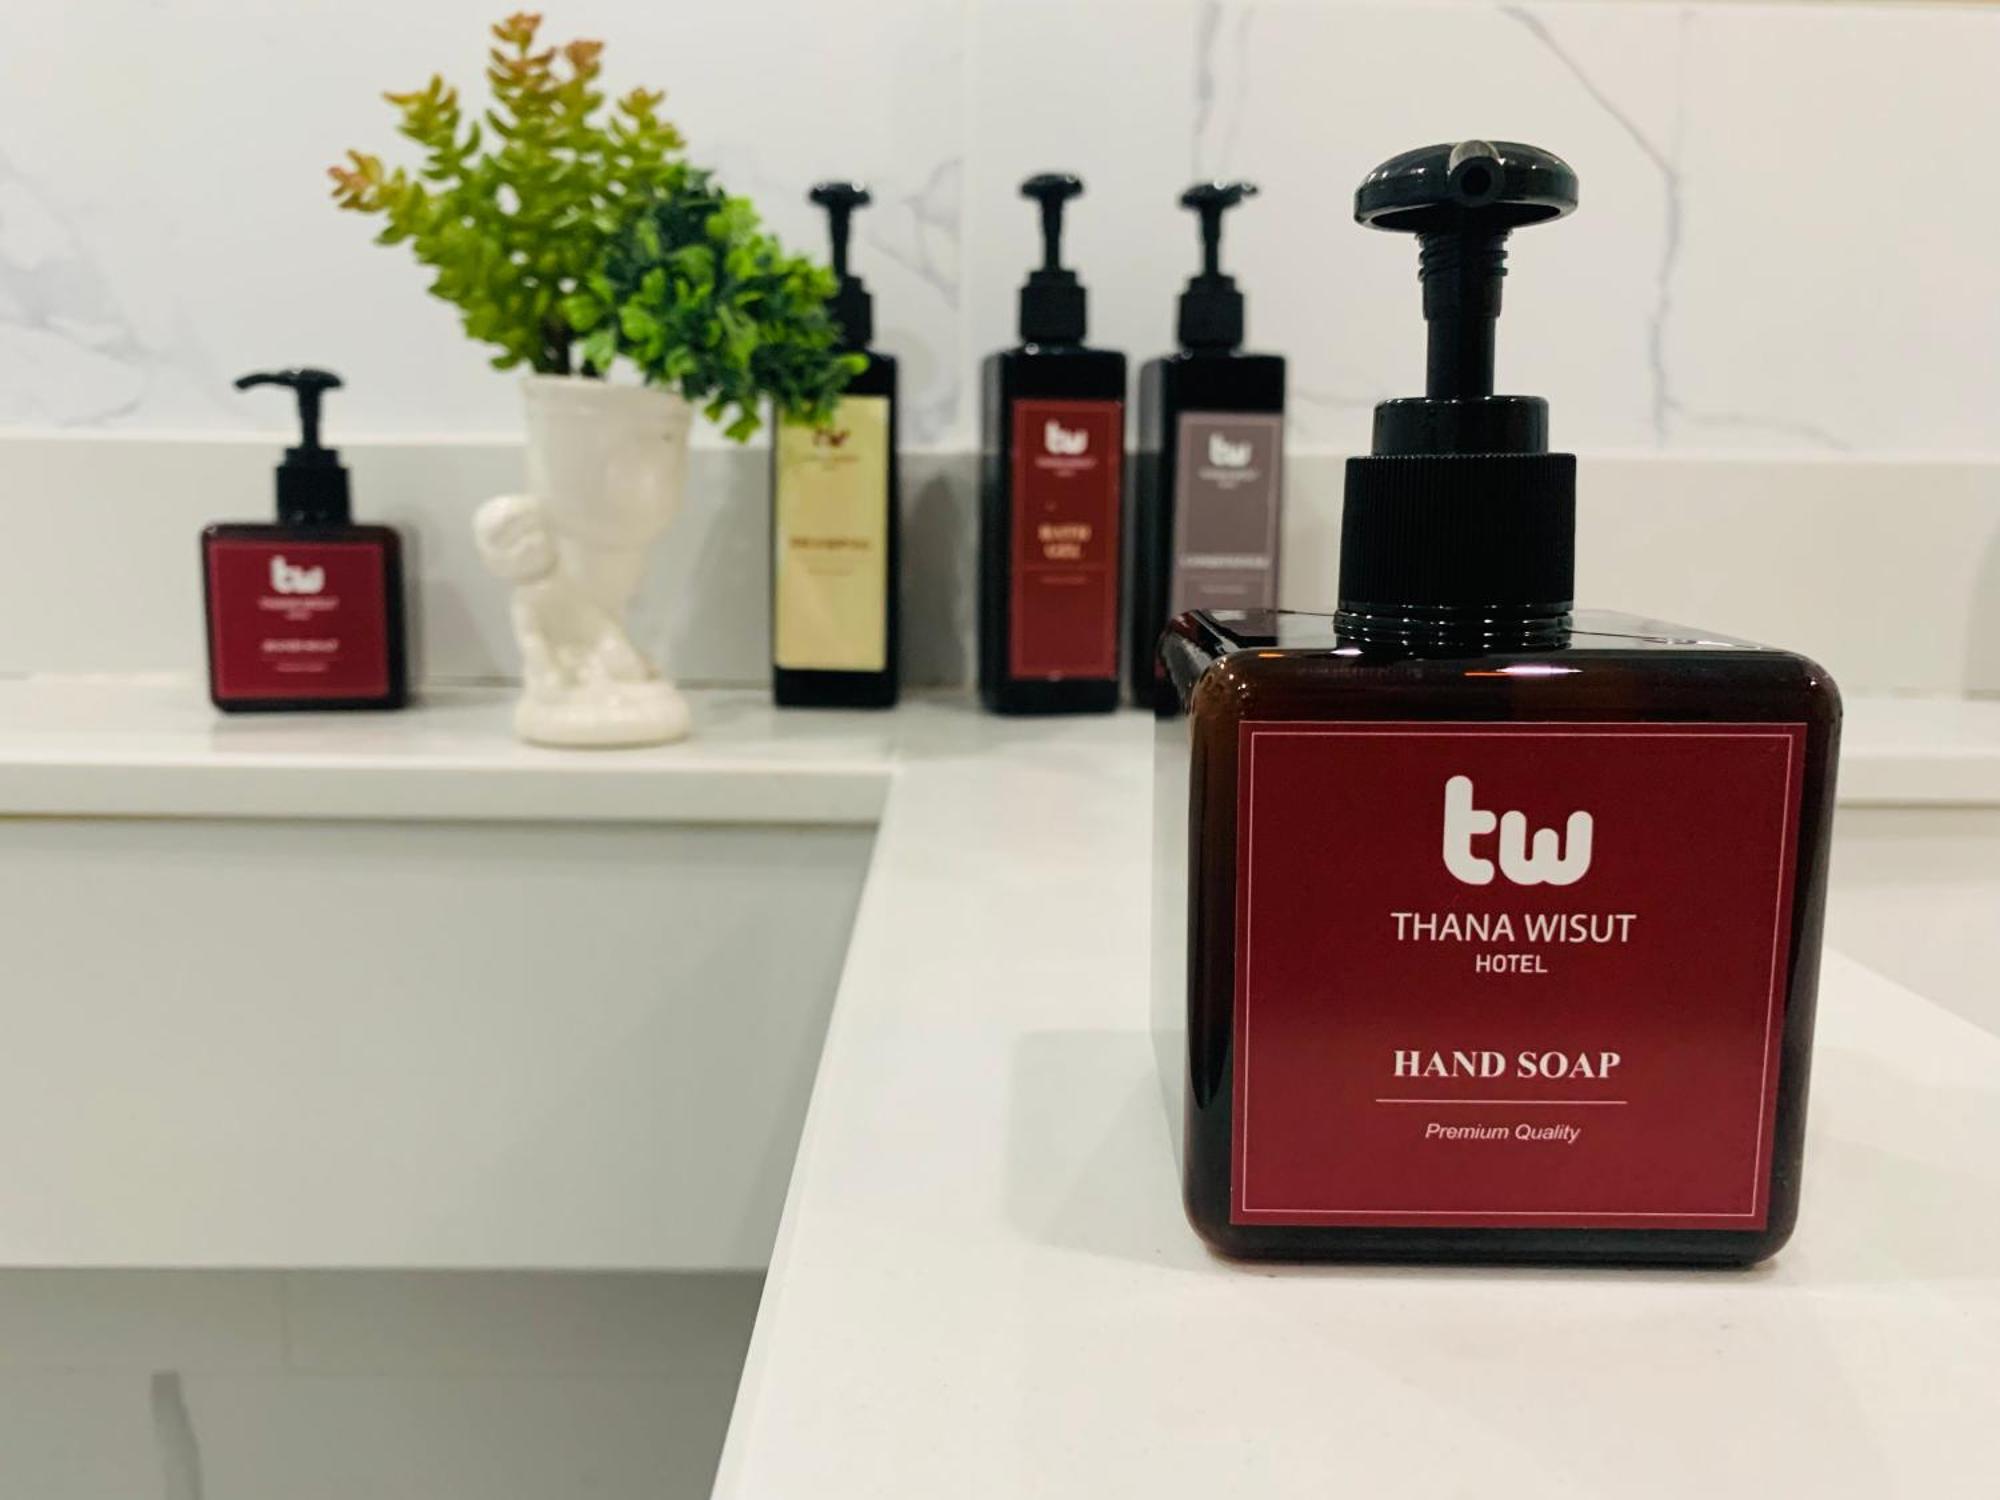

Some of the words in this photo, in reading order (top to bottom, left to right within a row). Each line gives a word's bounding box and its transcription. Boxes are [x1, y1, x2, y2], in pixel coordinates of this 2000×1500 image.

[1442, 775, 1594, 886] tw
[1389, 912, 1516, 942] THANA
[1524, 913, 1638, 943] WISUT
[1475, 954, 1549, 974] HOTEL
[1393, 1049, 1506, 1078] HAND
[1517, 1051, 1622, 1080] SOAP
[1424, 1122, 1510, 1141] Premium
[1514, 1124, 1582, 1144] Quality
